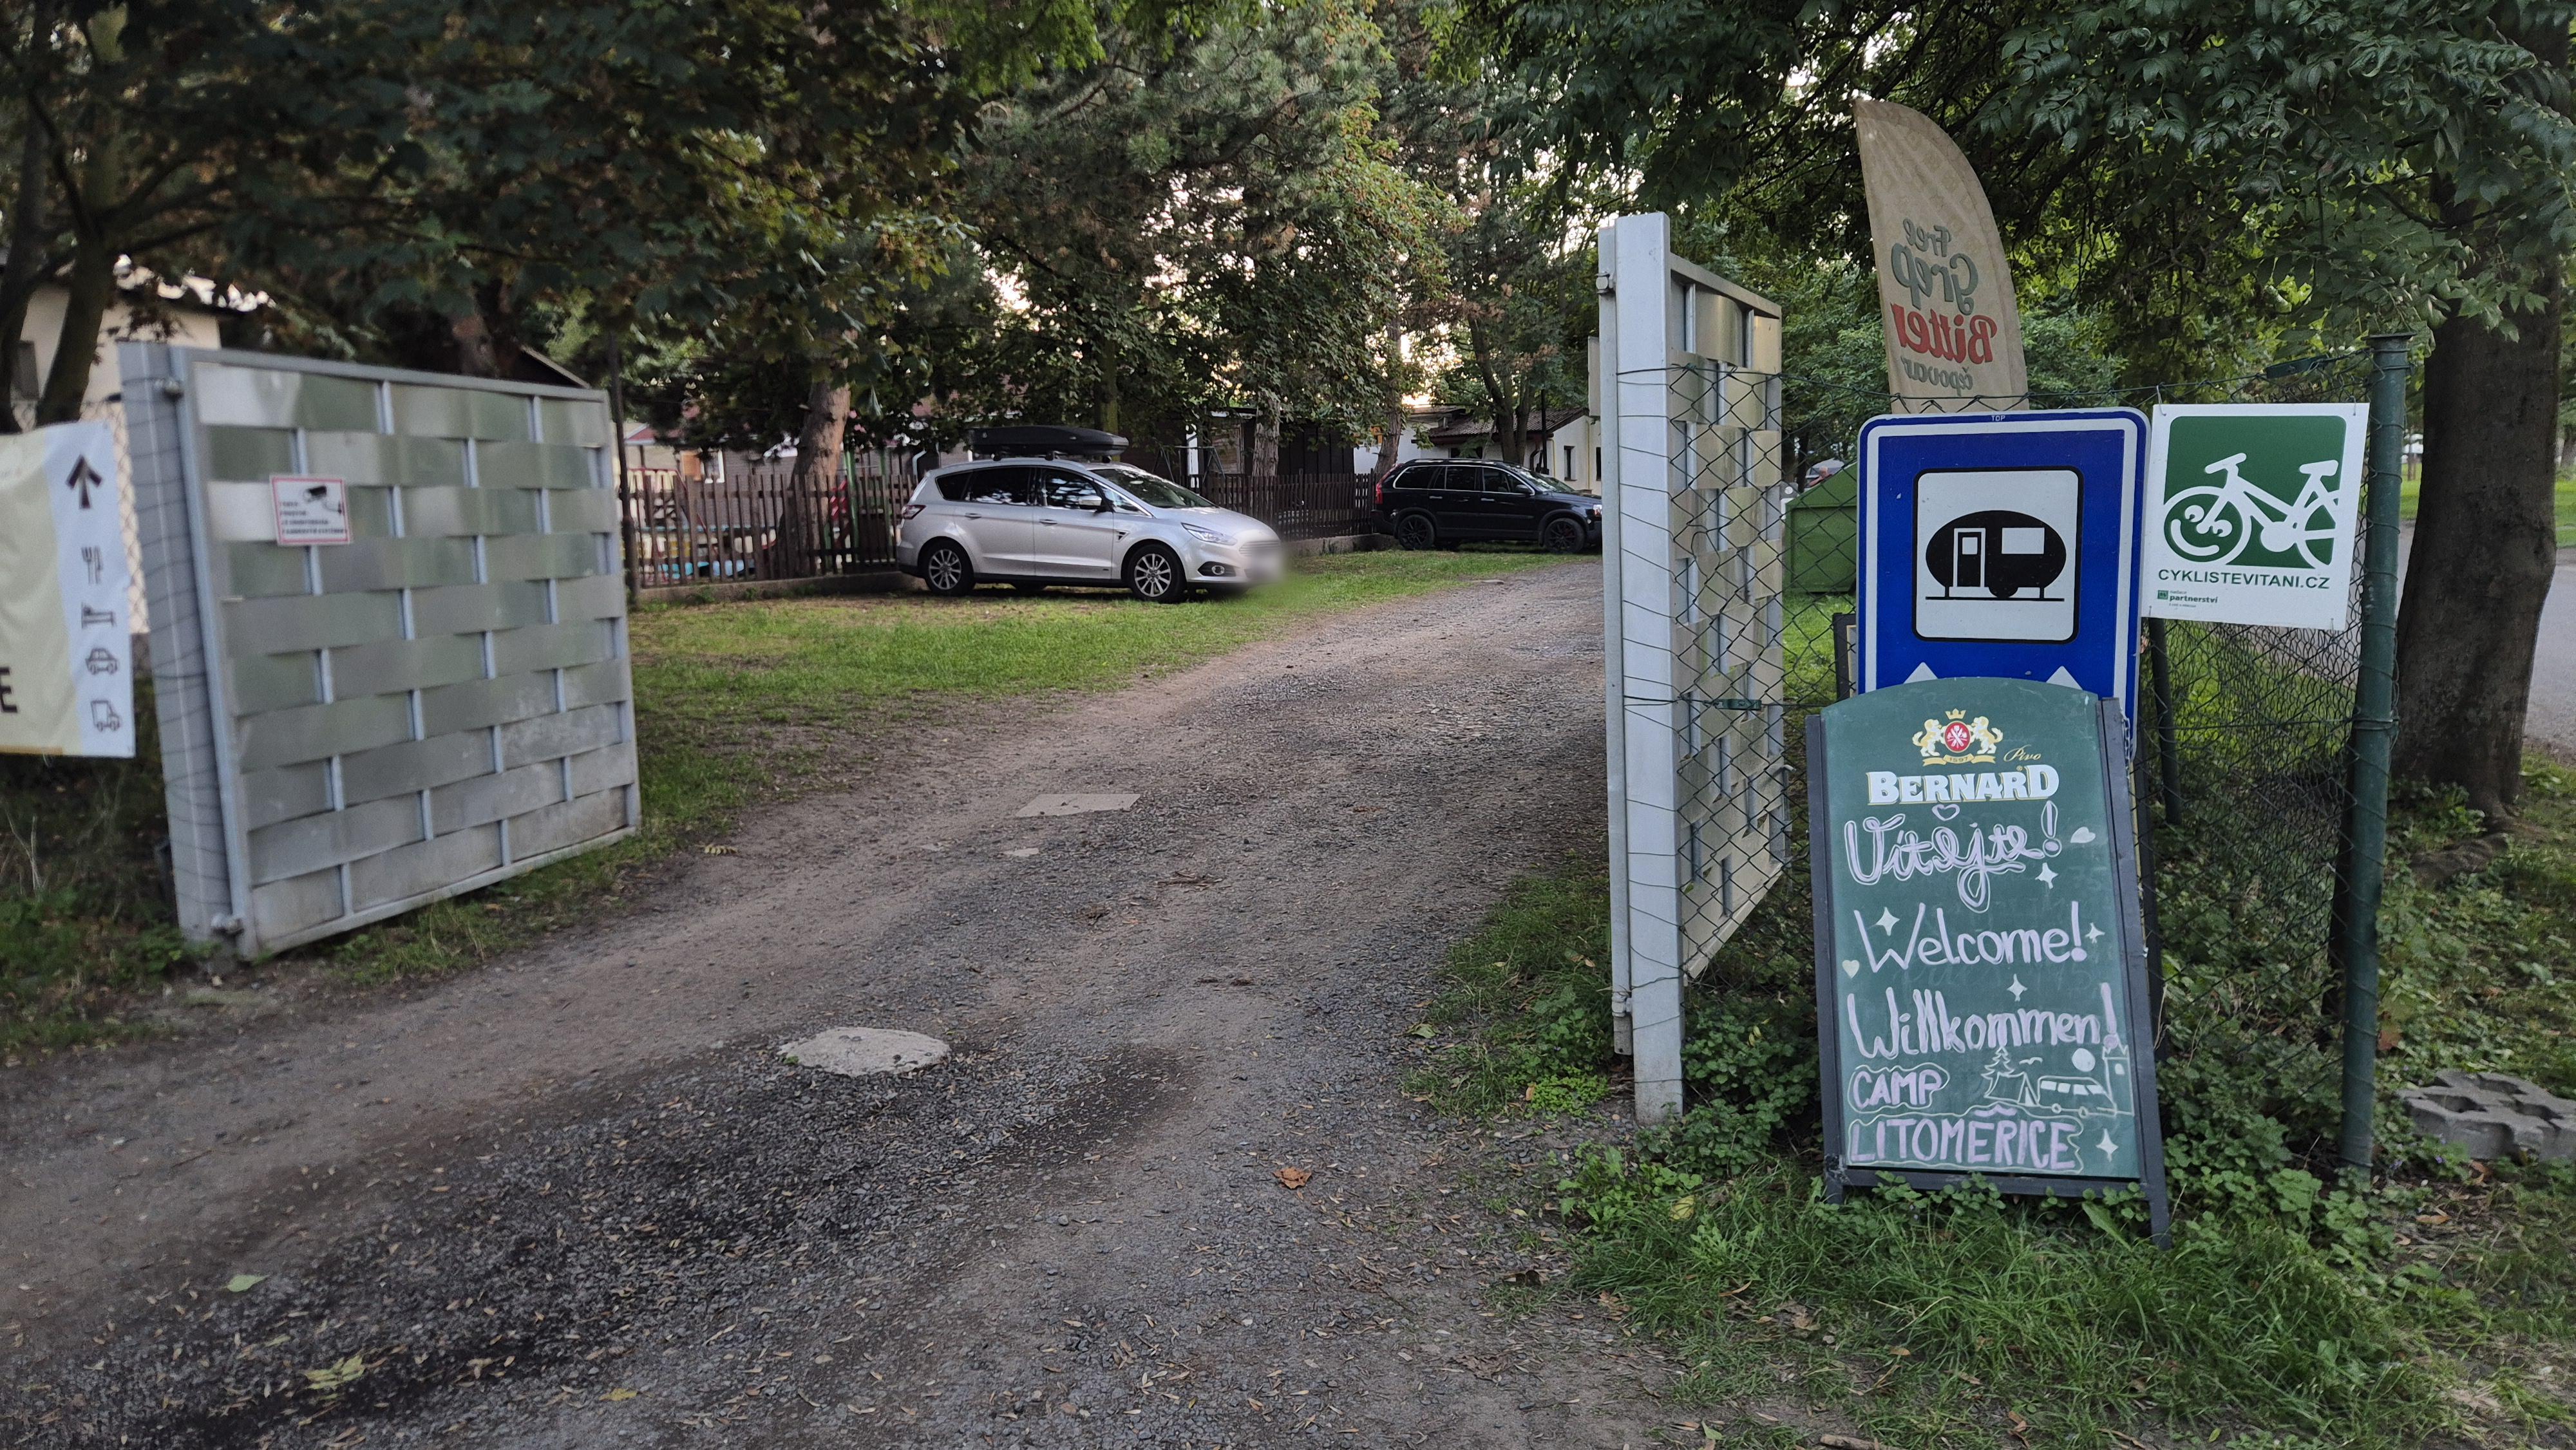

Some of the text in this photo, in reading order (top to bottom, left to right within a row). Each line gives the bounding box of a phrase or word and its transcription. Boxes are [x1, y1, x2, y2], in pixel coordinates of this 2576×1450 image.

[2158, 569, 2330, 588] CYKLISTEVITANI.CZ
[2003, 745, 2041, 762] Pivo
[1866, 764, 2060, 805] BERNARD
[1853, 901, 2087, 973] Welcome!
[1847, 983, 2117, 1060] Willkommen!
[1852, 1068, 1944, 1109] CAMP
